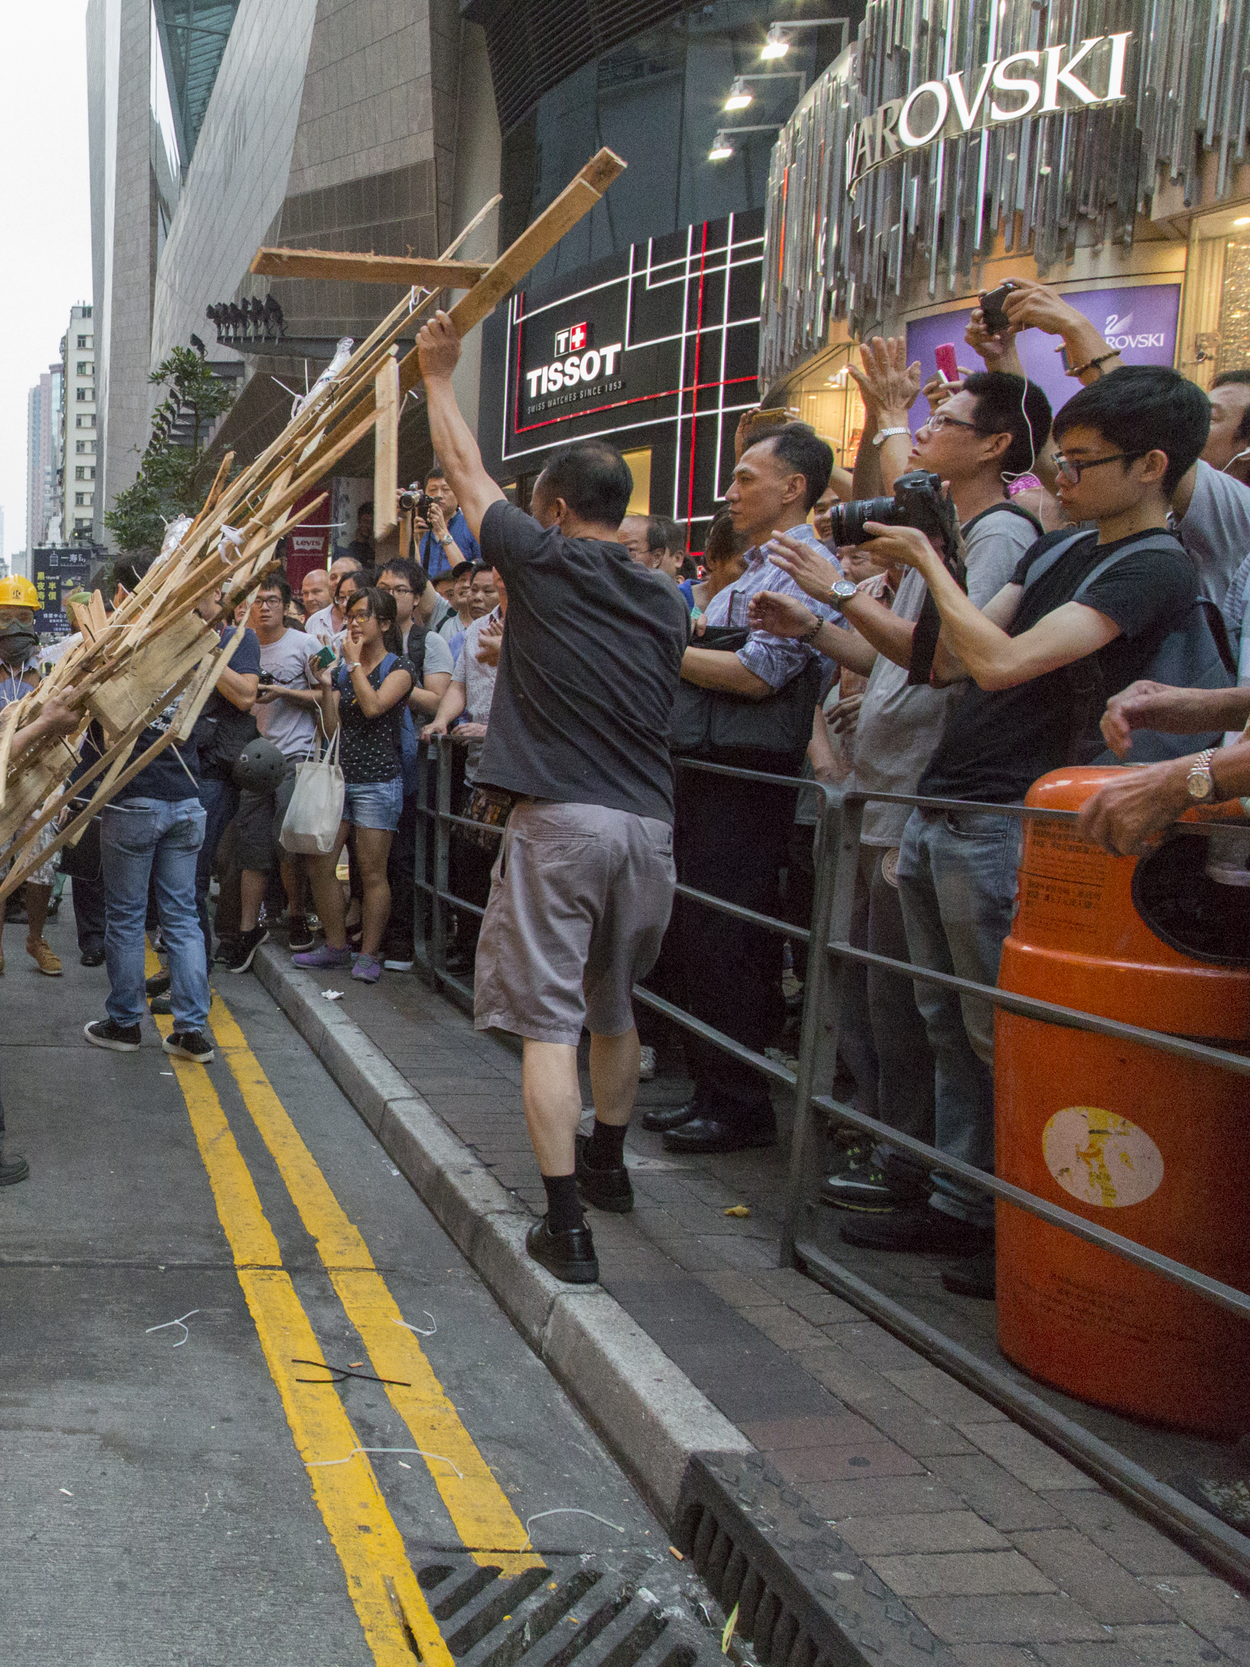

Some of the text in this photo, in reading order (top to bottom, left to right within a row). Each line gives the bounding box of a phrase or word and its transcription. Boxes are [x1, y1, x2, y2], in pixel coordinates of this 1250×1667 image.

[526, 342, 622, 398] TISSOT
[527, 380, 622, 414] SWISS WATCHES SINCE 1853
